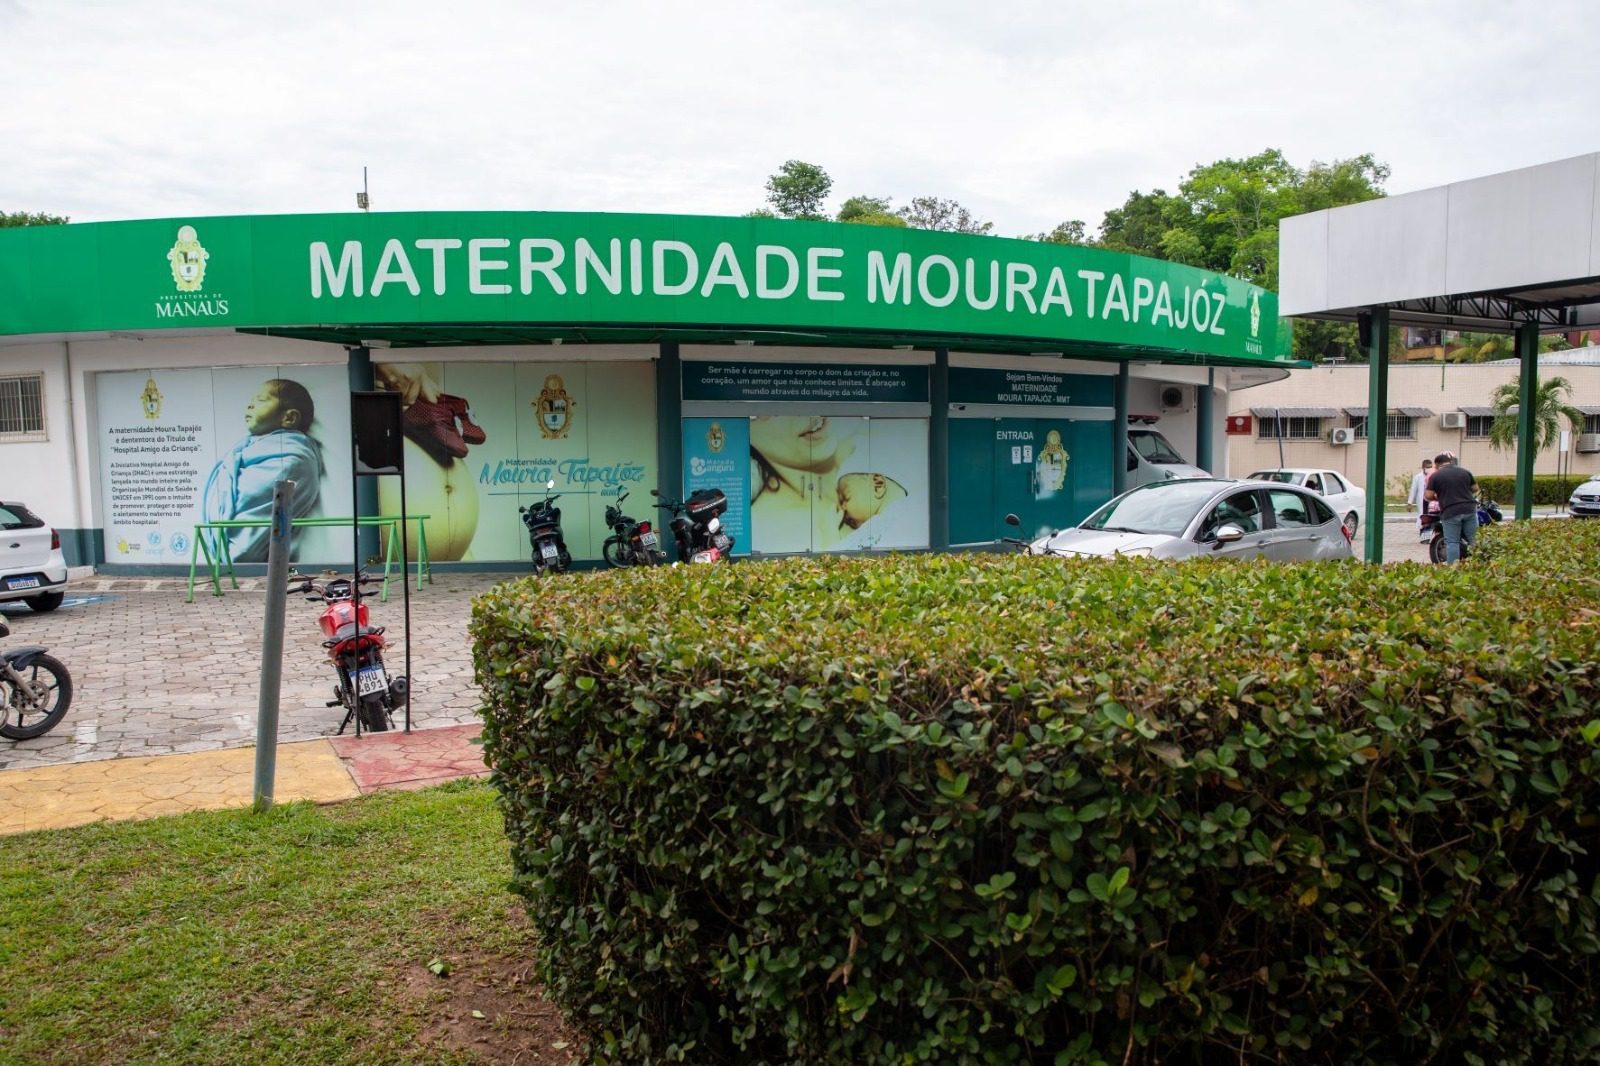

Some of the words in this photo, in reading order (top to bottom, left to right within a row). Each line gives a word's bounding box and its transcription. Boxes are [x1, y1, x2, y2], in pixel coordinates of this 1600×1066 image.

[309, 237, 846, 301] MATERNIDADE
[866, 250, 1074, 317] MOURA
[1077, 269, 1226, 336] TAPAJÓZ
[155, 300, 229, 318] MANAUS
[748, 368, 782, 376] carregar
[854, 369, 880, 378] criação
[1006, 372, 1025, 382] Sejam
[702, 377, 735, 385] coração,
[872, 379, 900, 388] abraçar
[812, 388, 840, 397] milagre
[1012, 384, 1058, 392] MATERNIDADE
[997, 393, 1022, 402] MOURA
[1024, 393, 1052, 403] TAPAJÓZ
[996, 431, 1034, 440] ENTRADA
[140, 446, 160, 454] Amigo
[480, 460, 552, 486] Moura
[558, 458, 646, 489] Tapajóz
[360, 672, 378, 684] PHU
